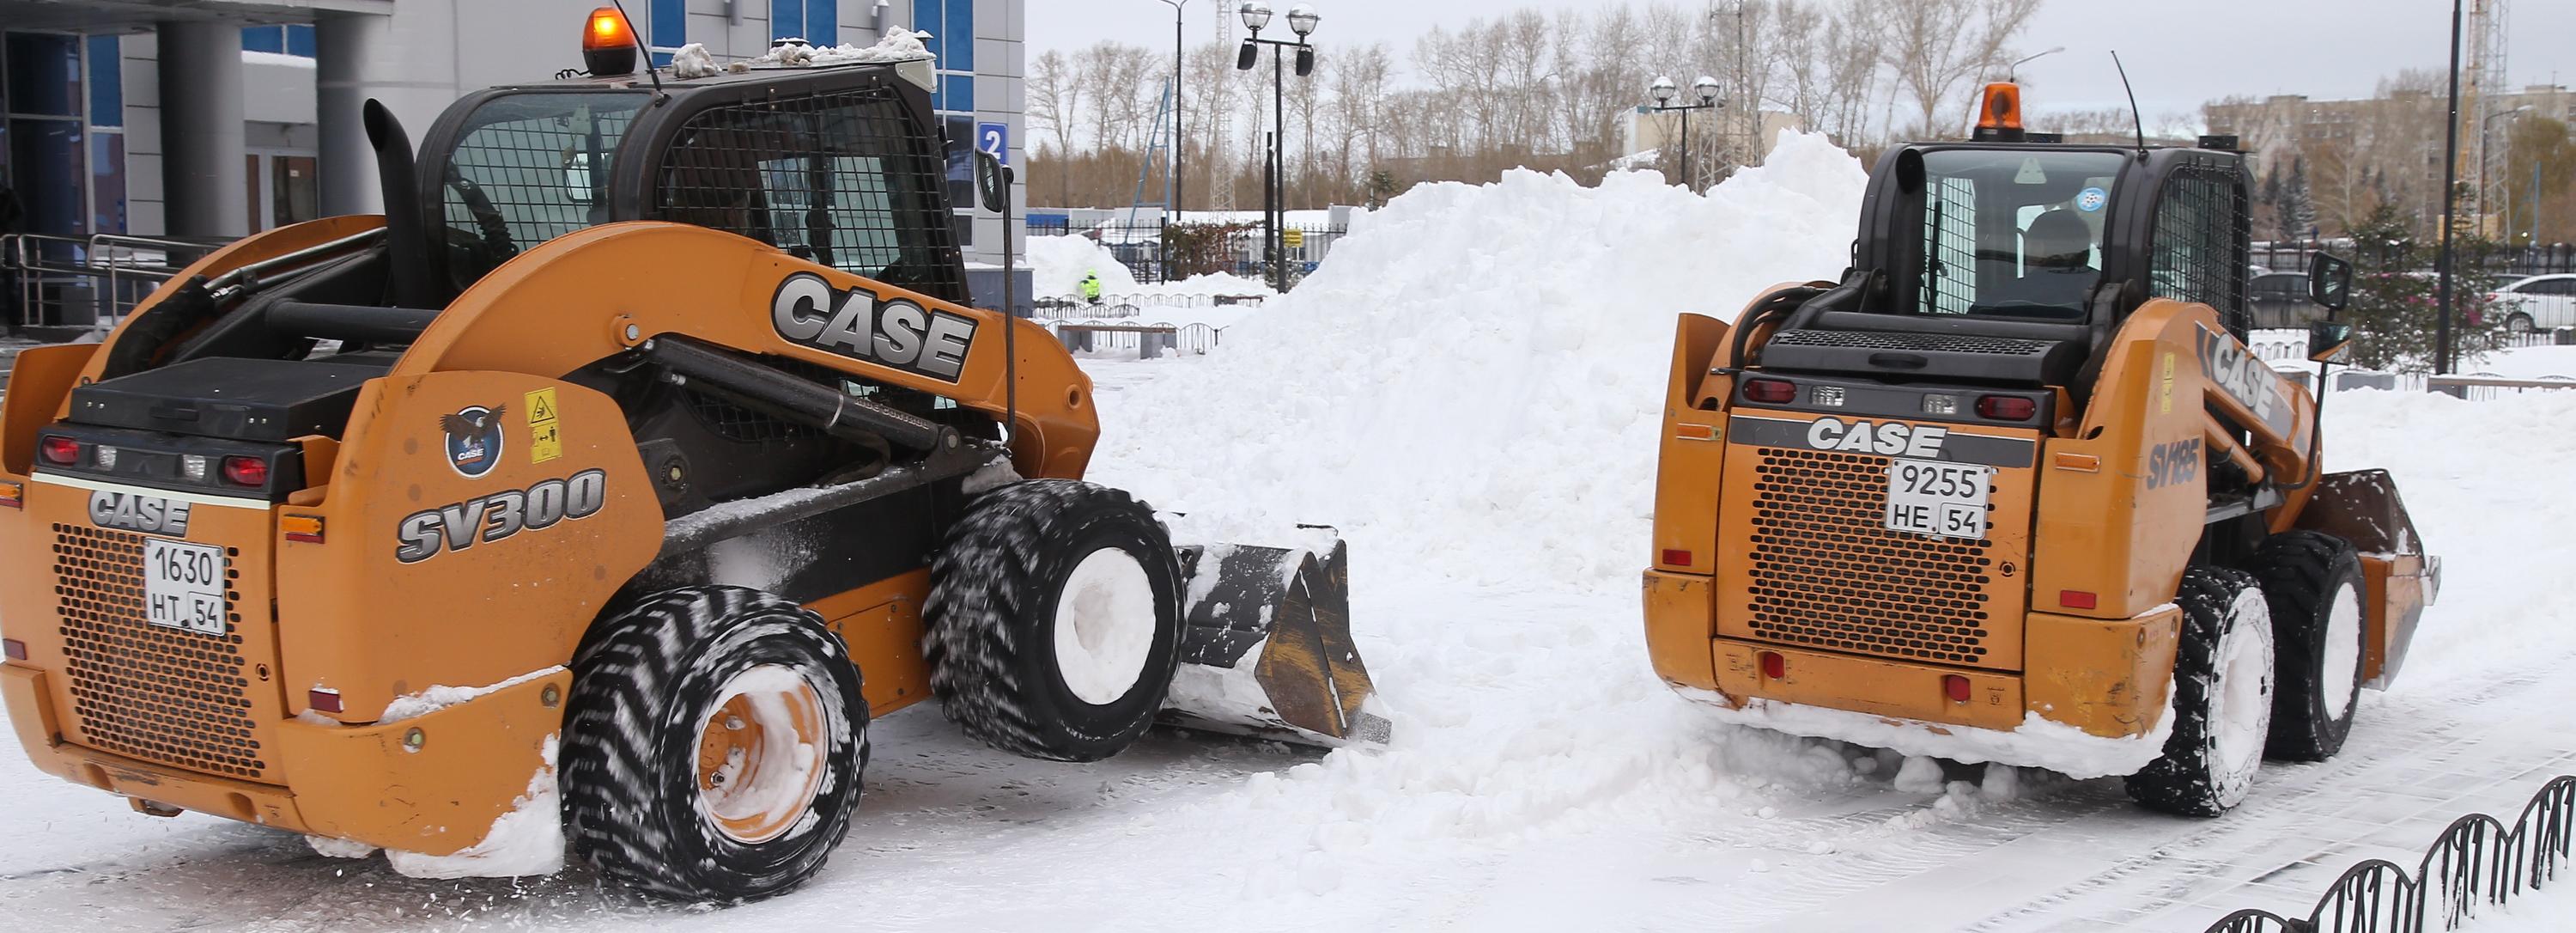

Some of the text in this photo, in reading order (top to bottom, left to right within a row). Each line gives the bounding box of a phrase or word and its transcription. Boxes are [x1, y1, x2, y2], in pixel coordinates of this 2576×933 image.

[985, 130, 1001, 160] 2
[773, 276, 975, 379] CASE
[2213, 333, 2276, 421] CASE
[457, 447, 484, 461] CASE
[1807, 418, 1947, 459] CASE
[1901, 465, 1978, 498] 9255
[2146, 438, 2200, 491] SV185
[89, 491, 191, 537] CASE
[398, 470, 606, 561] SV300
[1947, 509, 1977, 534] 54
[155, 546, 212, 586] 1630
[195, 599, 217, 628] 54
